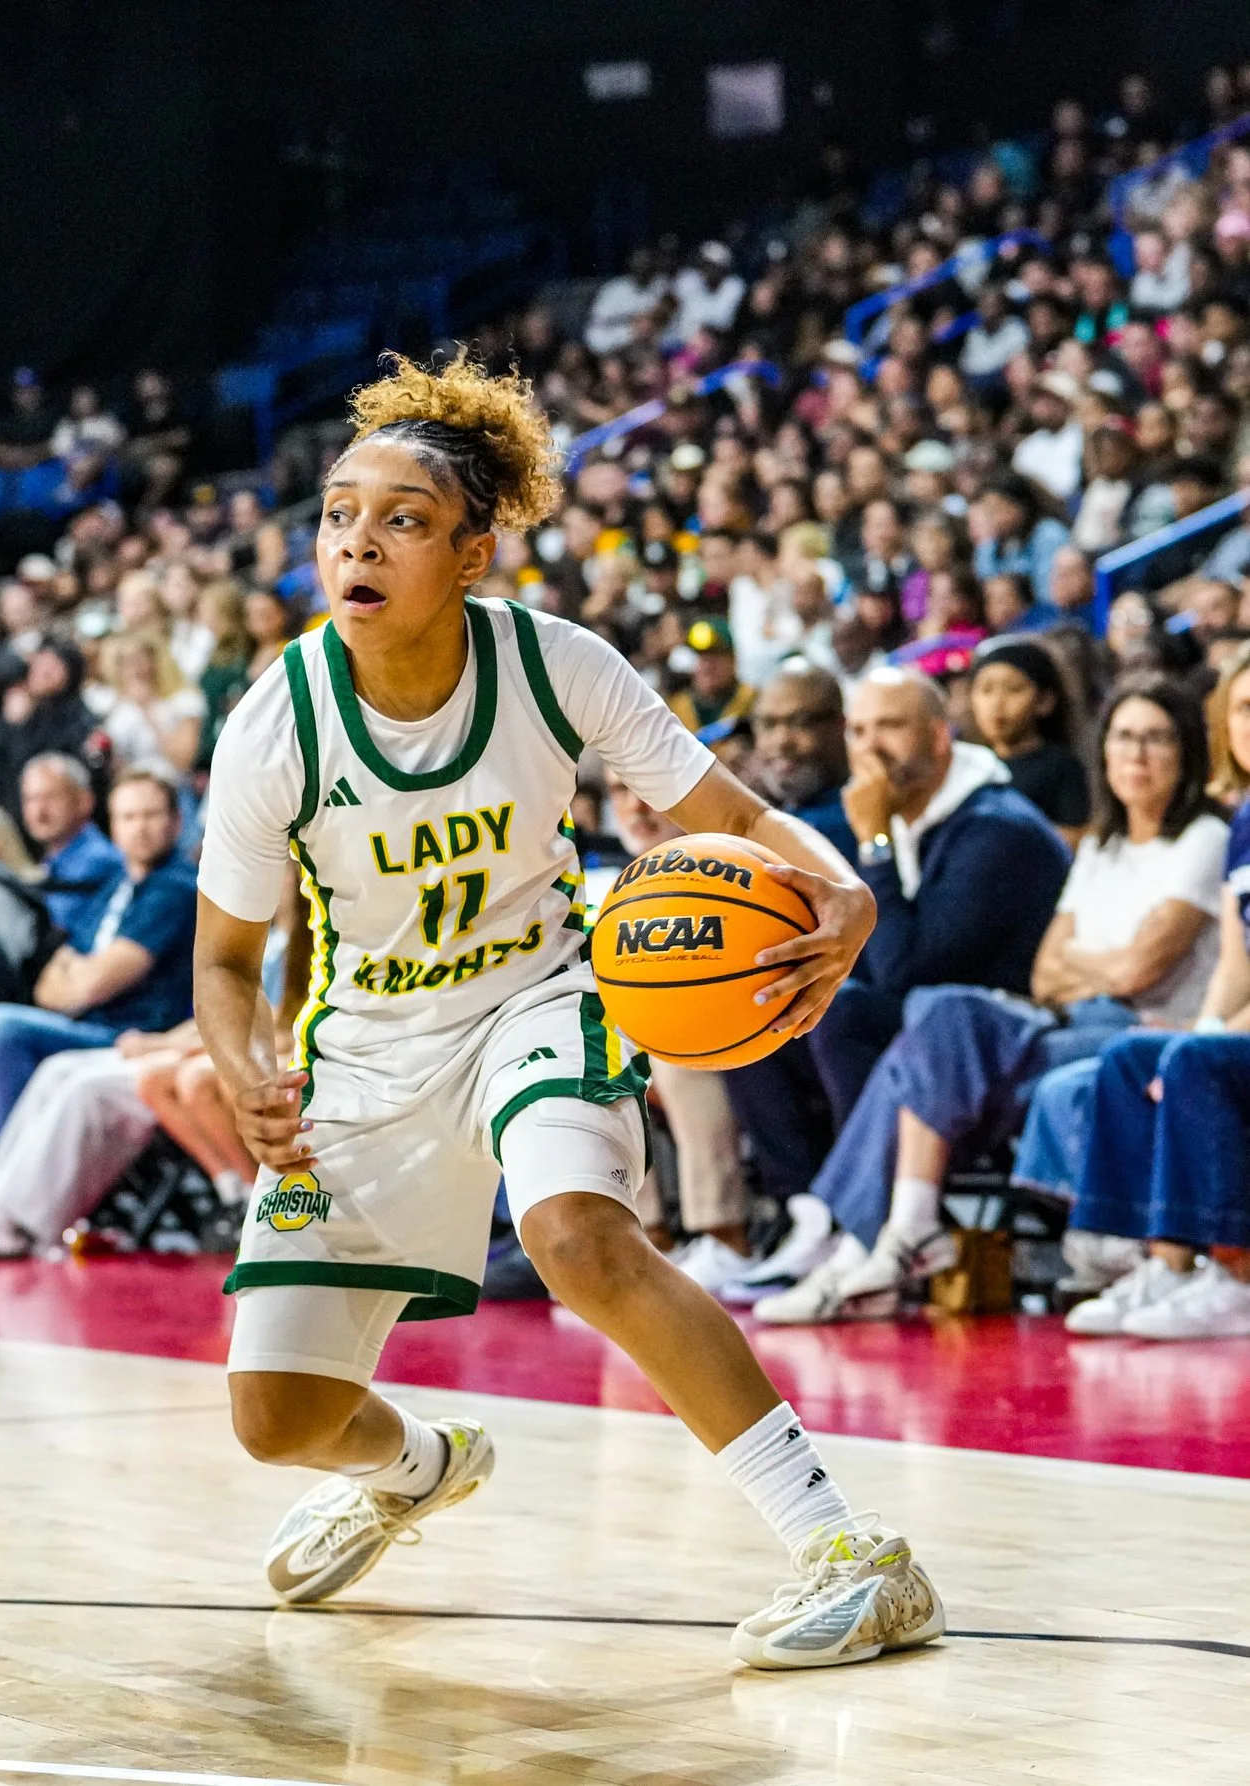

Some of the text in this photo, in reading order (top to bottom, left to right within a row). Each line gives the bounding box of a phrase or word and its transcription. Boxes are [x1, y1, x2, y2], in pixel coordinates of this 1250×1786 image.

[368, 801, 516, 877] LADY
[613, 848, 753, 894] Wilson
[418, 868, 490, 950] 11
[615, 915, 725, 956] NCAA
[255, 1190, 334, 1224] CHRISTIAN
